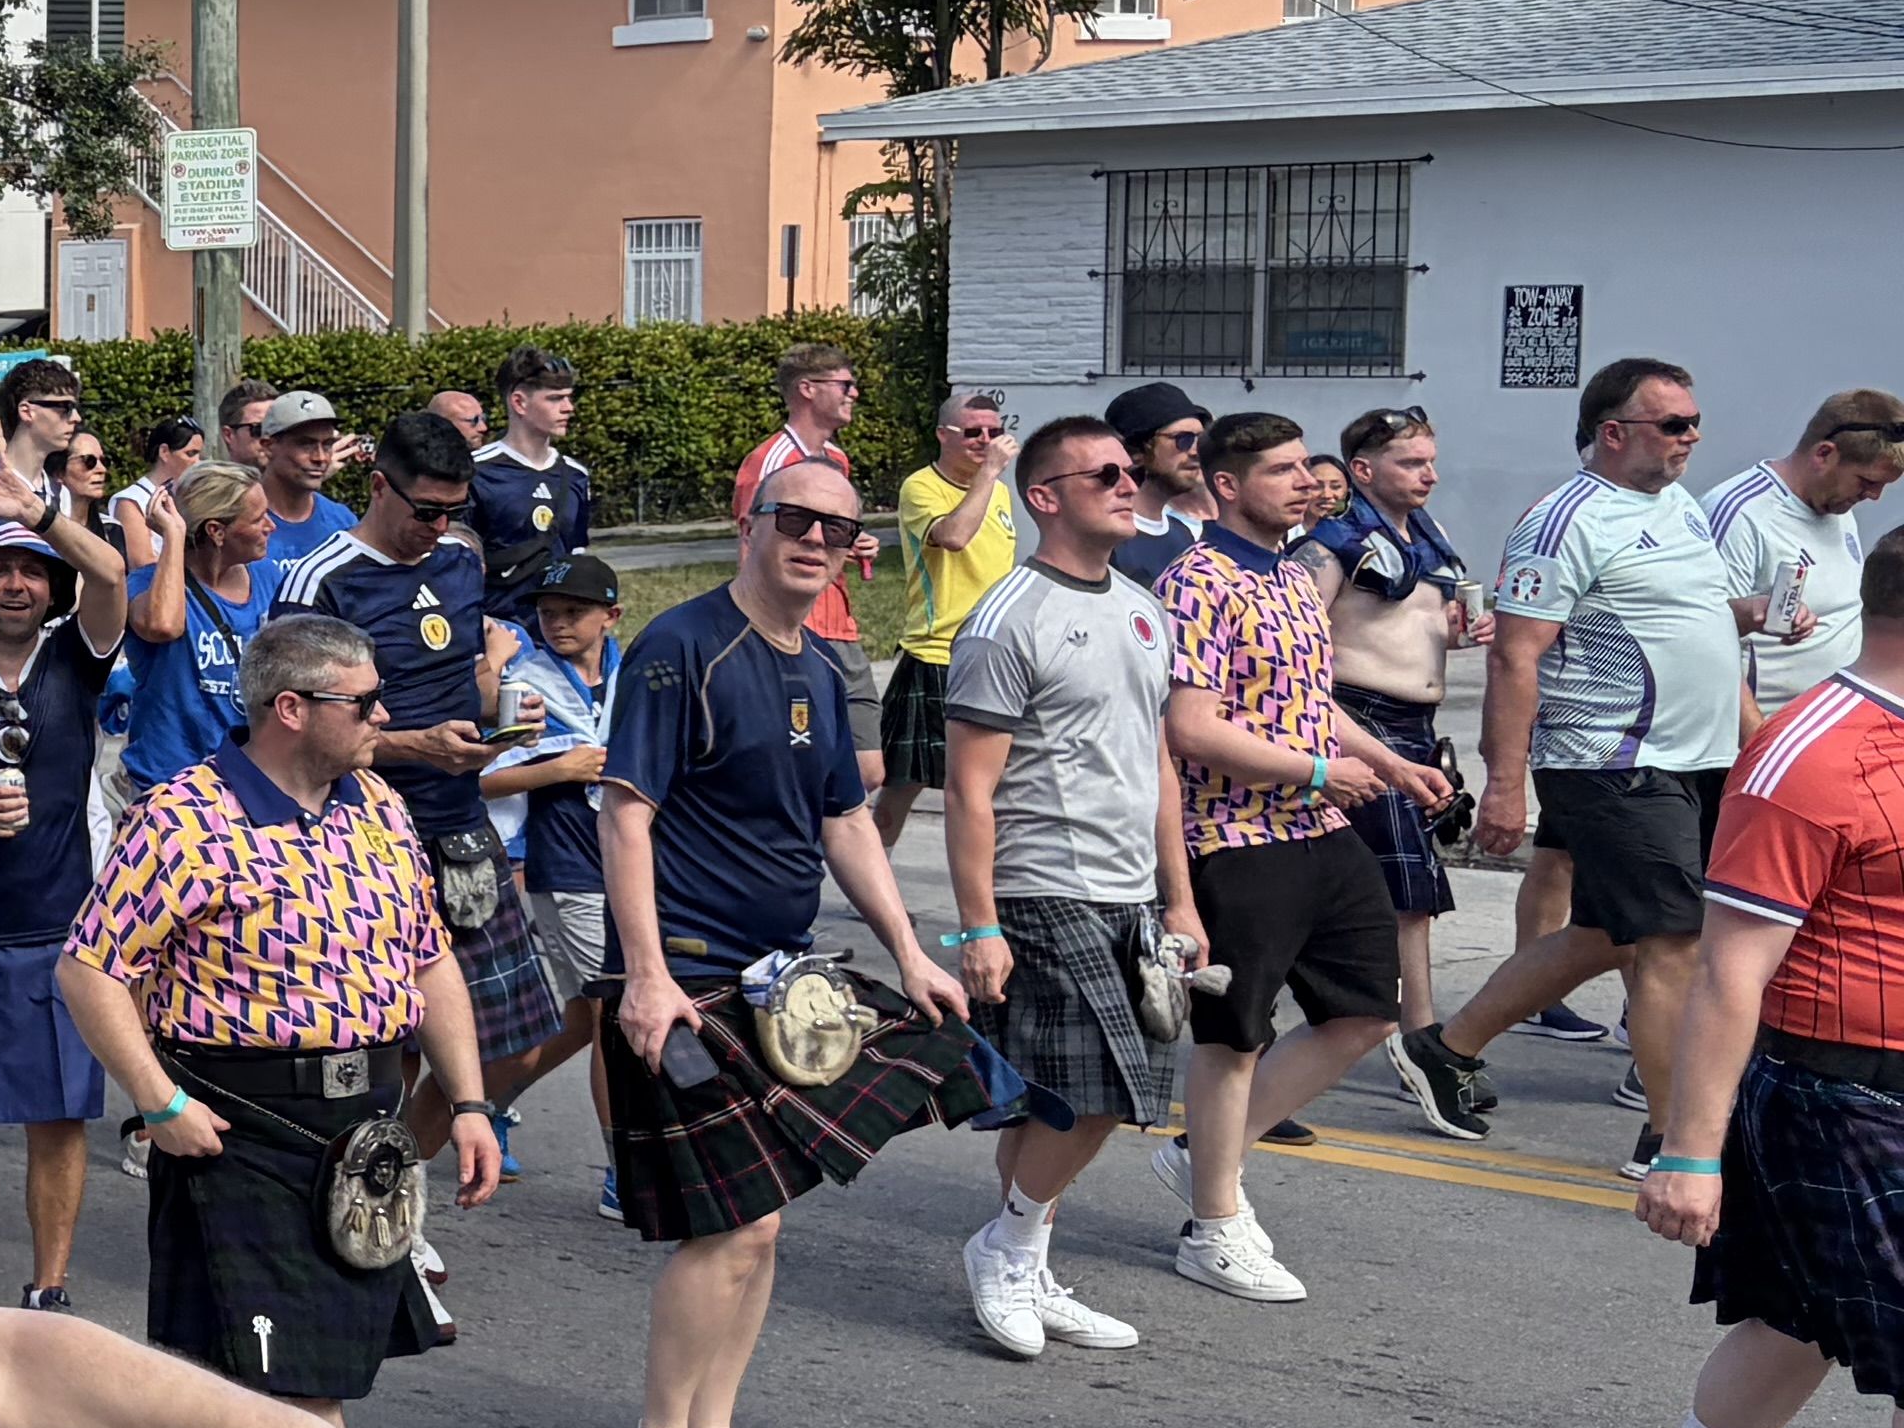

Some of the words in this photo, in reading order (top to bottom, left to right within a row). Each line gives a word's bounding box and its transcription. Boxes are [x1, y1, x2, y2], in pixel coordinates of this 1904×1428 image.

[175, 135, 245, 148] RESIDENTIAL
[171, 149, 218, 161] PARKING
[220, 147, 250, 159] ZONE
[187, 166, 234, 179] DURING
[177, 178, 245, 191] STADIUM
[180, 189, 242, 202] EVENTS
[174, 205, 247, 214] RESIDENTIAL
[174, 214, 215, 223] PERMIT
[218, 213, 248, 221] ONLY
[1527, 306, 1560, 327] ZONE
[1567, 305, 1575, 317] 7
